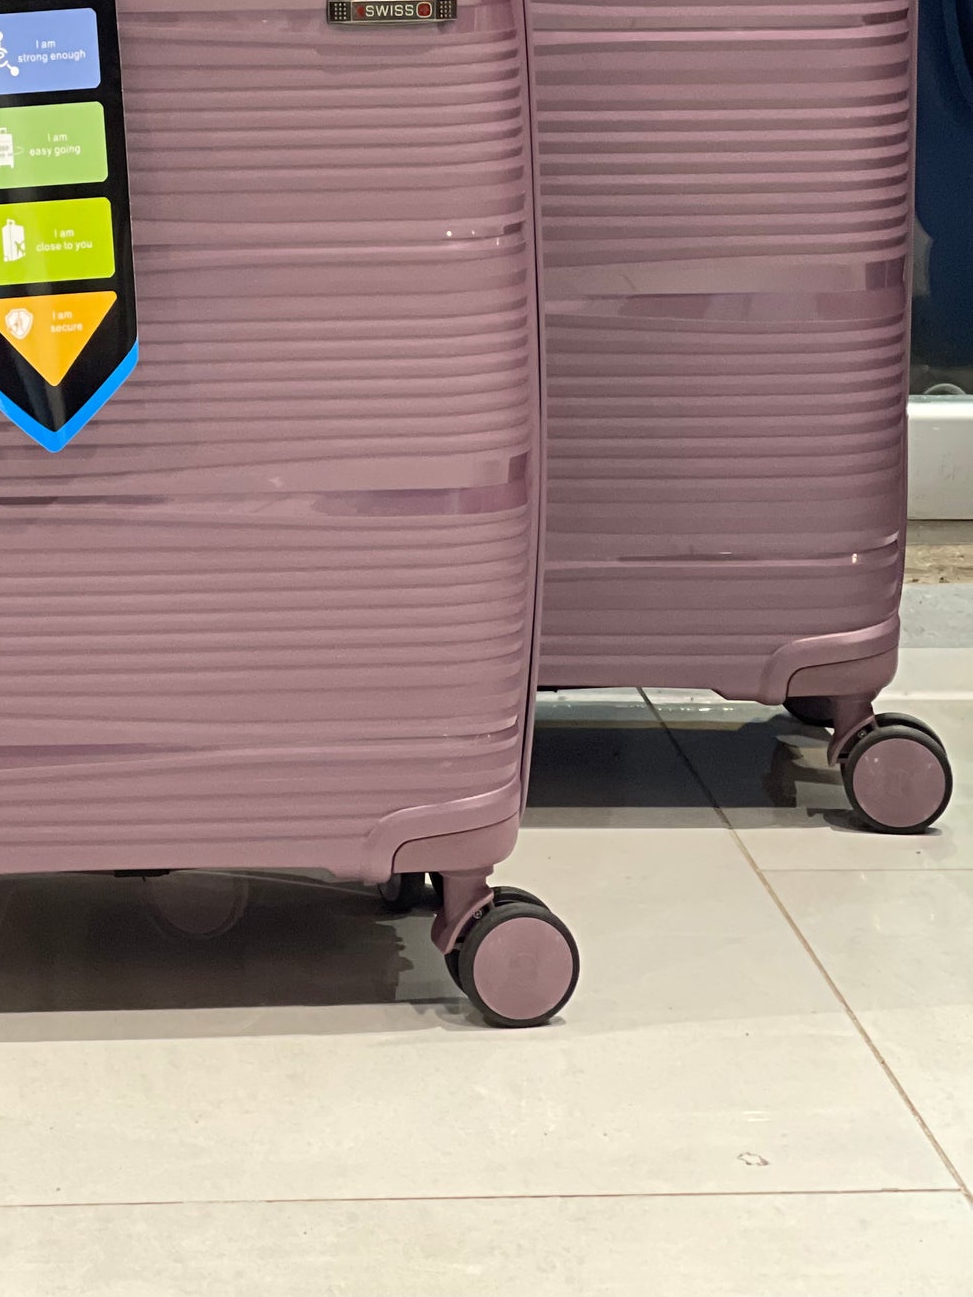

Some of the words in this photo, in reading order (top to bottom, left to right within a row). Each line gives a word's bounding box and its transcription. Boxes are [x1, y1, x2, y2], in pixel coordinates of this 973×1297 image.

[35, 39, 39, 49] I
[41, 40, 56, 49] am
[18, 54, 49, 64] strong
[50, 51, 87, 62] enough
[47, 133, 51, 142] I
[52, 134, 68, 142] am
[29, 148, 52, 158] easy
[53, 144, 82, 157] going
[54, 229, 58, 239] I
[60, 229, 75, 238] am
[36, 243, 62, 253] close
[63, 242, 73, 251] to
[75, 241, 93, 253] you
[52, 310, 55, 319] I
[58, 311, 73, 319] am
[50, 322, 83, 333] secure
